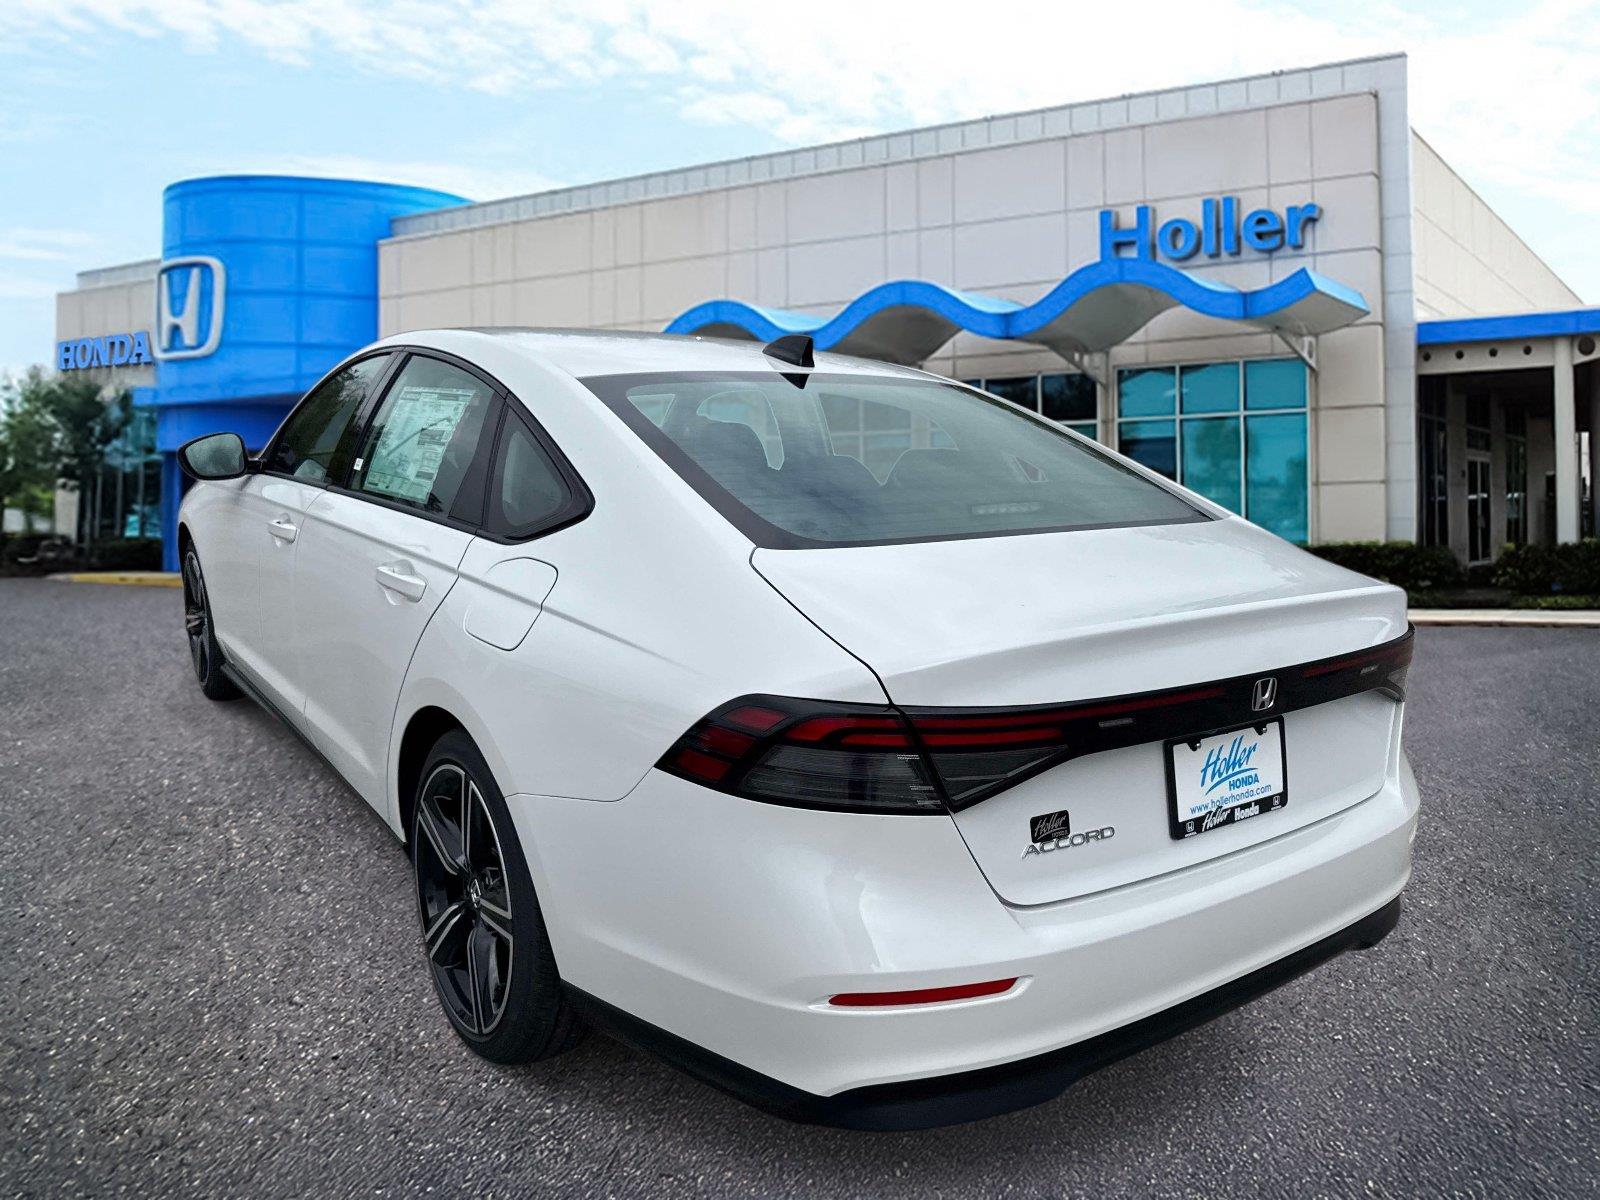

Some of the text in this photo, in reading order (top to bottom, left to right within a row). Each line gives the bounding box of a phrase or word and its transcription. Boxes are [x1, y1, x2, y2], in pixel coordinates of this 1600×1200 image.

[1099, 196, 1321, 262] Holler
[57, 331, 153, 371] HONDA
[1200, 735, 1258, 788] Holler
[1228, 773, 1260, 791] HONDA
[1189, 784, 1272, 815] www.hollerhonda.com
[1034, 812, 1067, 837] Holler
[1201, 802, 1260, 832] Holler Honda
[1021, 826, 1115, 859] ACCORD
